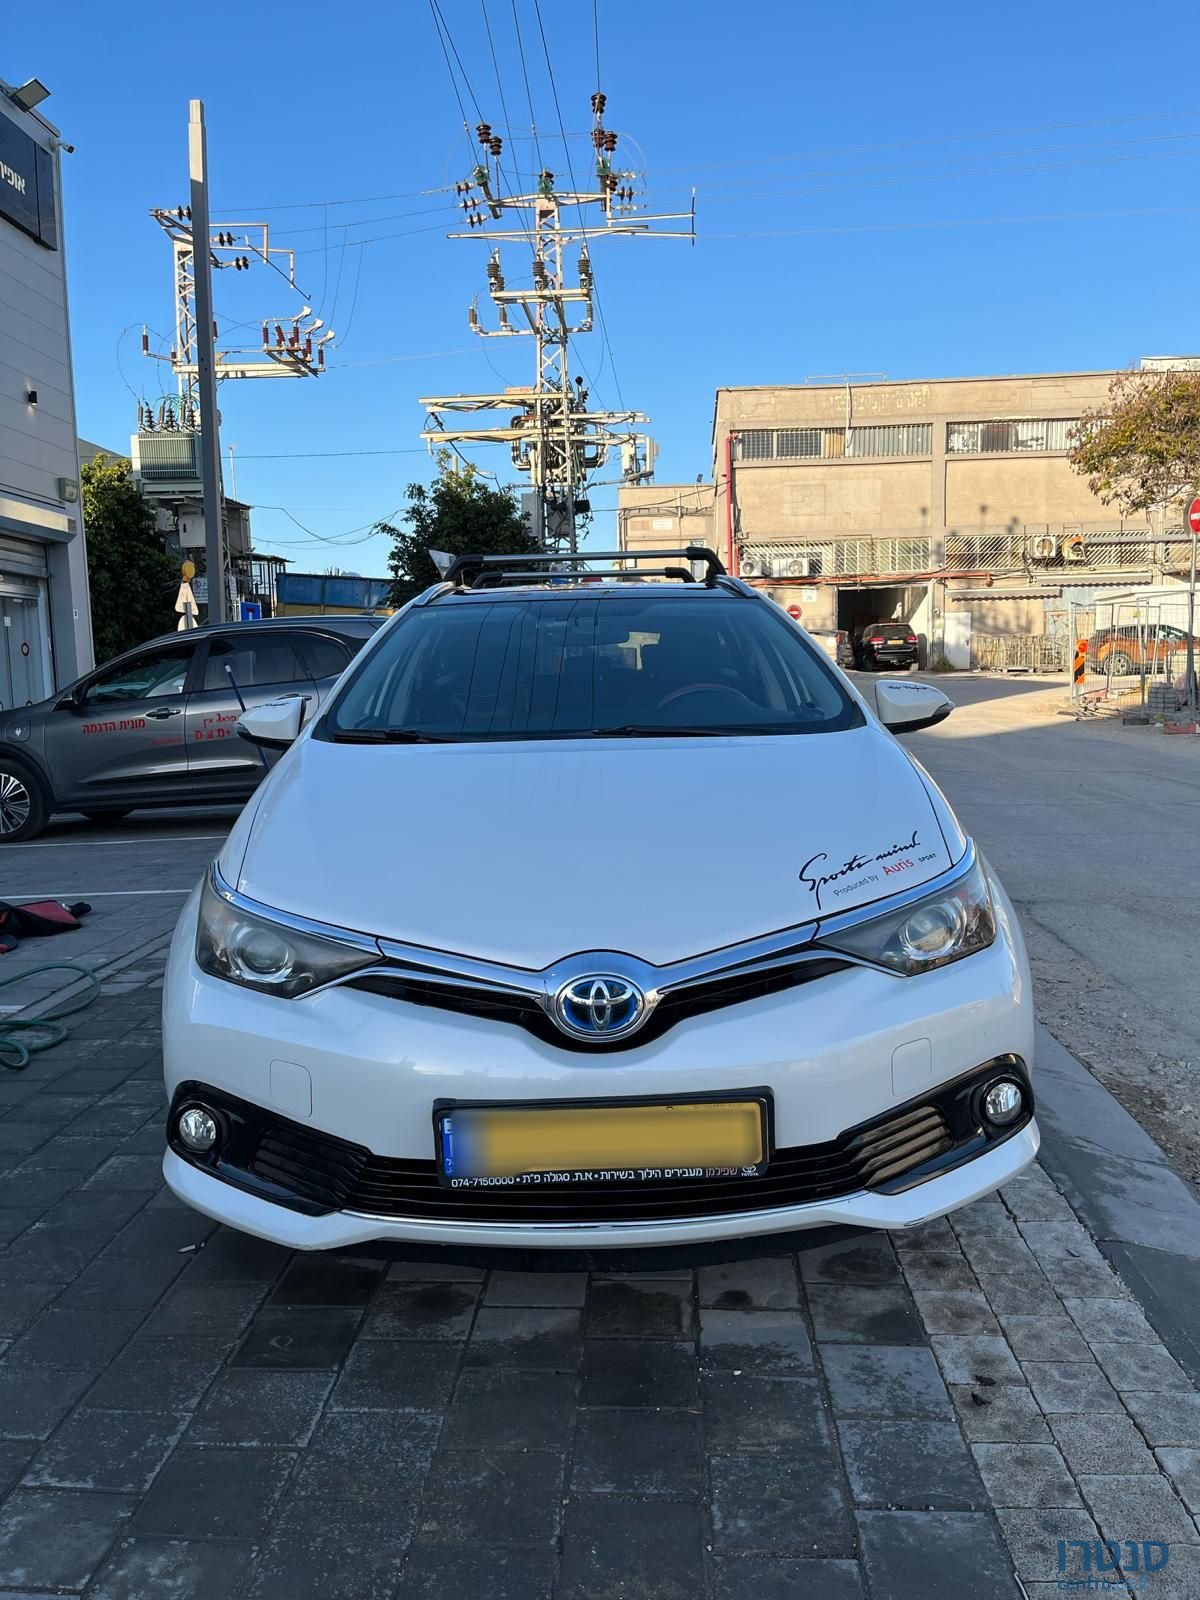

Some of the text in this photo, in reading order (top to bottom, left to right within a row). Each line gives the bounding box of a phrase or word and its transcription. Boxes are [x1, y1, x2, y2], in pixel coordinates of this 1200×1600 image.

[833, 853, 937, 897] Produced by Auris SPORT
[543, 1171, 570, 1183] סגולה
[599, 1170, 635, 1180] בשירות
[637, 1168, 662, 1181] הילוך
[664, 1168, 703, 1178] מעבירים
[705, 1167, 738, 1178] שפילמן
[451, 1176, 515, 1188] 074-7150000
